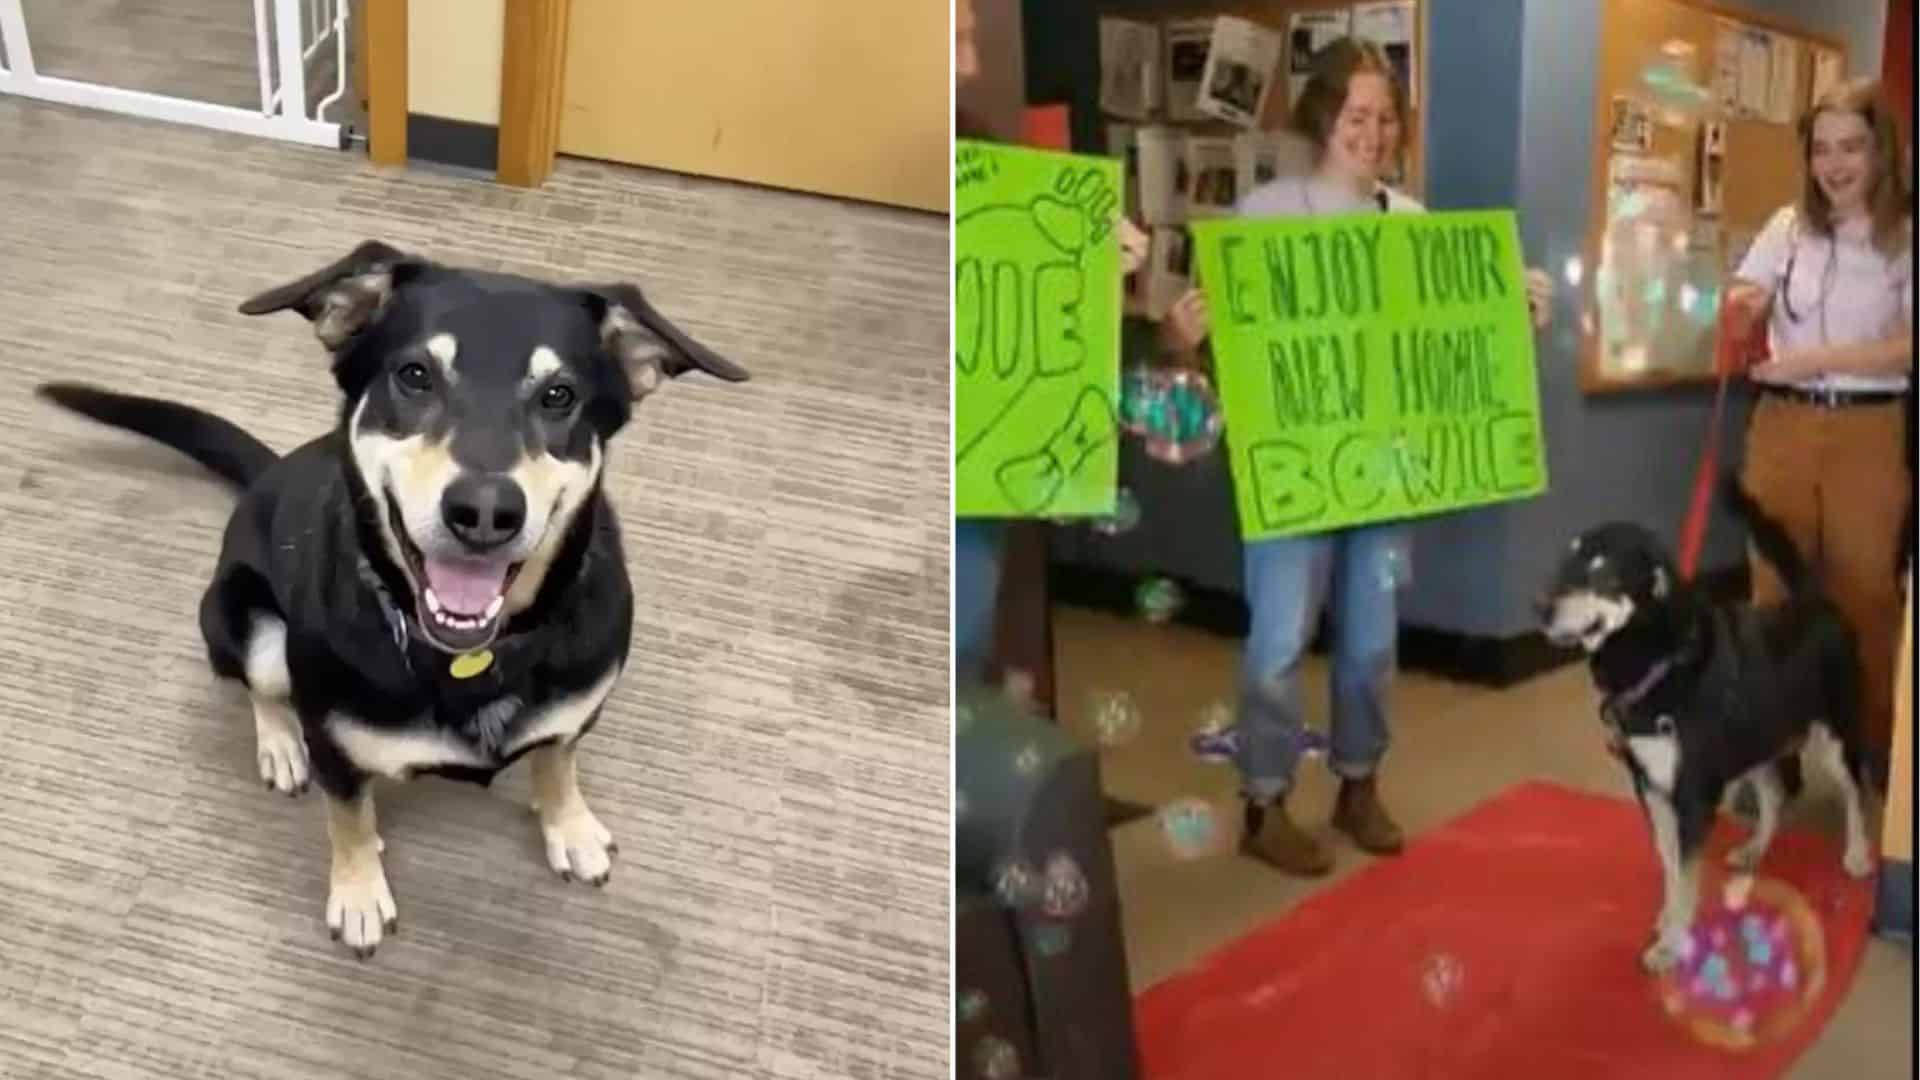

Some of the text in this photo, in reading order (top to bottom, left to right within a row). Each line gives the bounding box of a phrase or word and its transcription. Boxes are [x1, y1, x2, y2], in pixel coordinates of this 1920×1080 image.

[1219, 223, 1507, 323] ENJOY YOUR
[1267, 325, 1509, 429] NEW HOME
[1248, 411, 1535, 530] BOWIE
